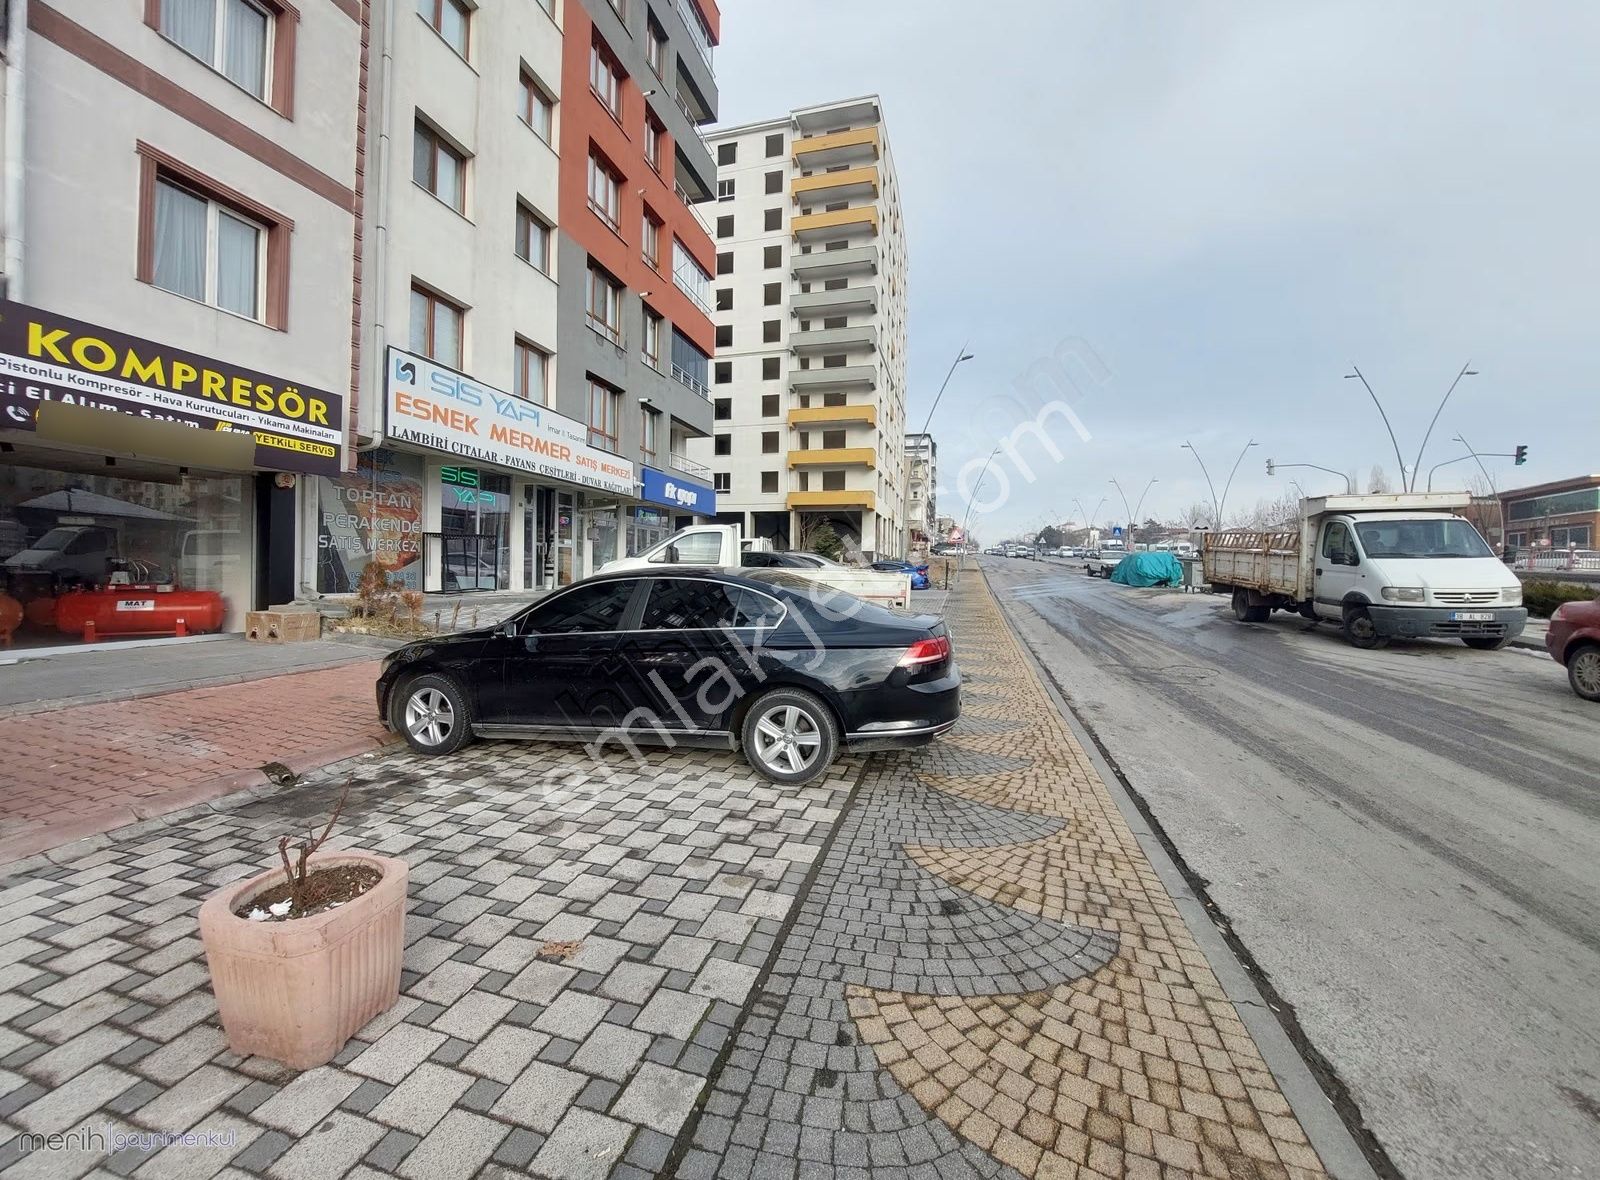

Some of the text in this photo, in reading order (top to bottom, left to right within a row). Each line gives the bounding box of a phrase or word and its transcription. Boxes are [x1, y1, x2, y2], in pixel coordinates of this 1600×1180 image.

[28, 322, 329, 425] KOMPRESÖR
[67, 372, 142, 398] Kompresör
[154, 392, 182, 406] Hava
[185, 399, 250, 422] Kurutucuları
[258, 416, 290, 431] Yıkama
[395, 391, 481, 436] ESNEK
[490, 423, 571, 462] MERMER
[575, 454, 598, 472] SATIŞ
[489, 392, 540, 428] YAPI
[392, 425, 448, 450] LAMBİRİ
[451, 441, 498, 462] ÇITALAR
[505, 454, 536, 471] FAYANS
[581, 475, 602, 488] DUVAR
[322, 512, 421, 534] PERAKENDE
[333, 485, 412, 509] TOPTAN
